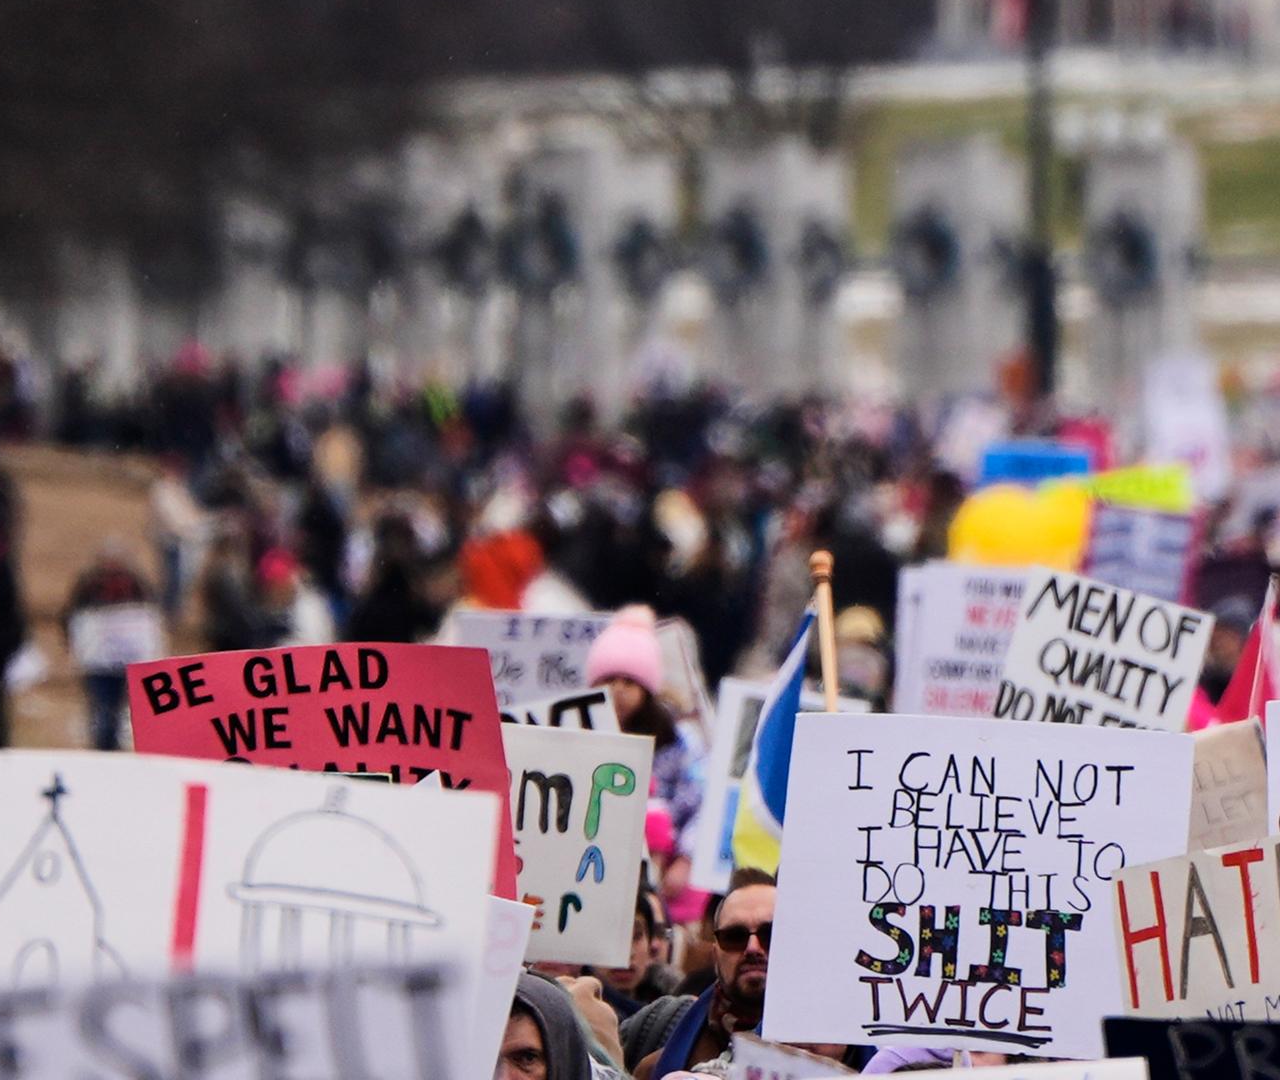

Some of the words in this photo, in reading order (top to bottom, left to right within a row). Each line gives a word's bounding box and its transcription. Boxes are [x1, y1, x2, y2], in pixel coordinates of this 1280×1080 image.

[1026, 576, 1135, 643] MEN
[1140, 606, 1201, 659] OF
[142, 662, 214, 715] BE
[243, 648, 389, 698] GLAD
[994, 680, 1035, 721] DO
[1039, 638, 1184, 716] QUALITY
[211, 706, 293, 756] WE
[324, 701, 472, 751] WANT
[847, 749, 875, 791] I
[898, 752, 996, 798] CAN
[1034, 759, 1135, 806] NOT
[888, 788, 1086, 839] BELIEVE
[856, 826, 883, 865] I
[914, 828, 1028, 876] HAVE
[1067, 840, 1126, 881] TO
[862, 863, 925, 906] DO
[970, 869, 1092, 913] THIS
[854, 902, 1084, 988] SHIT
[858, 976, 1052, 1032] TWICE
